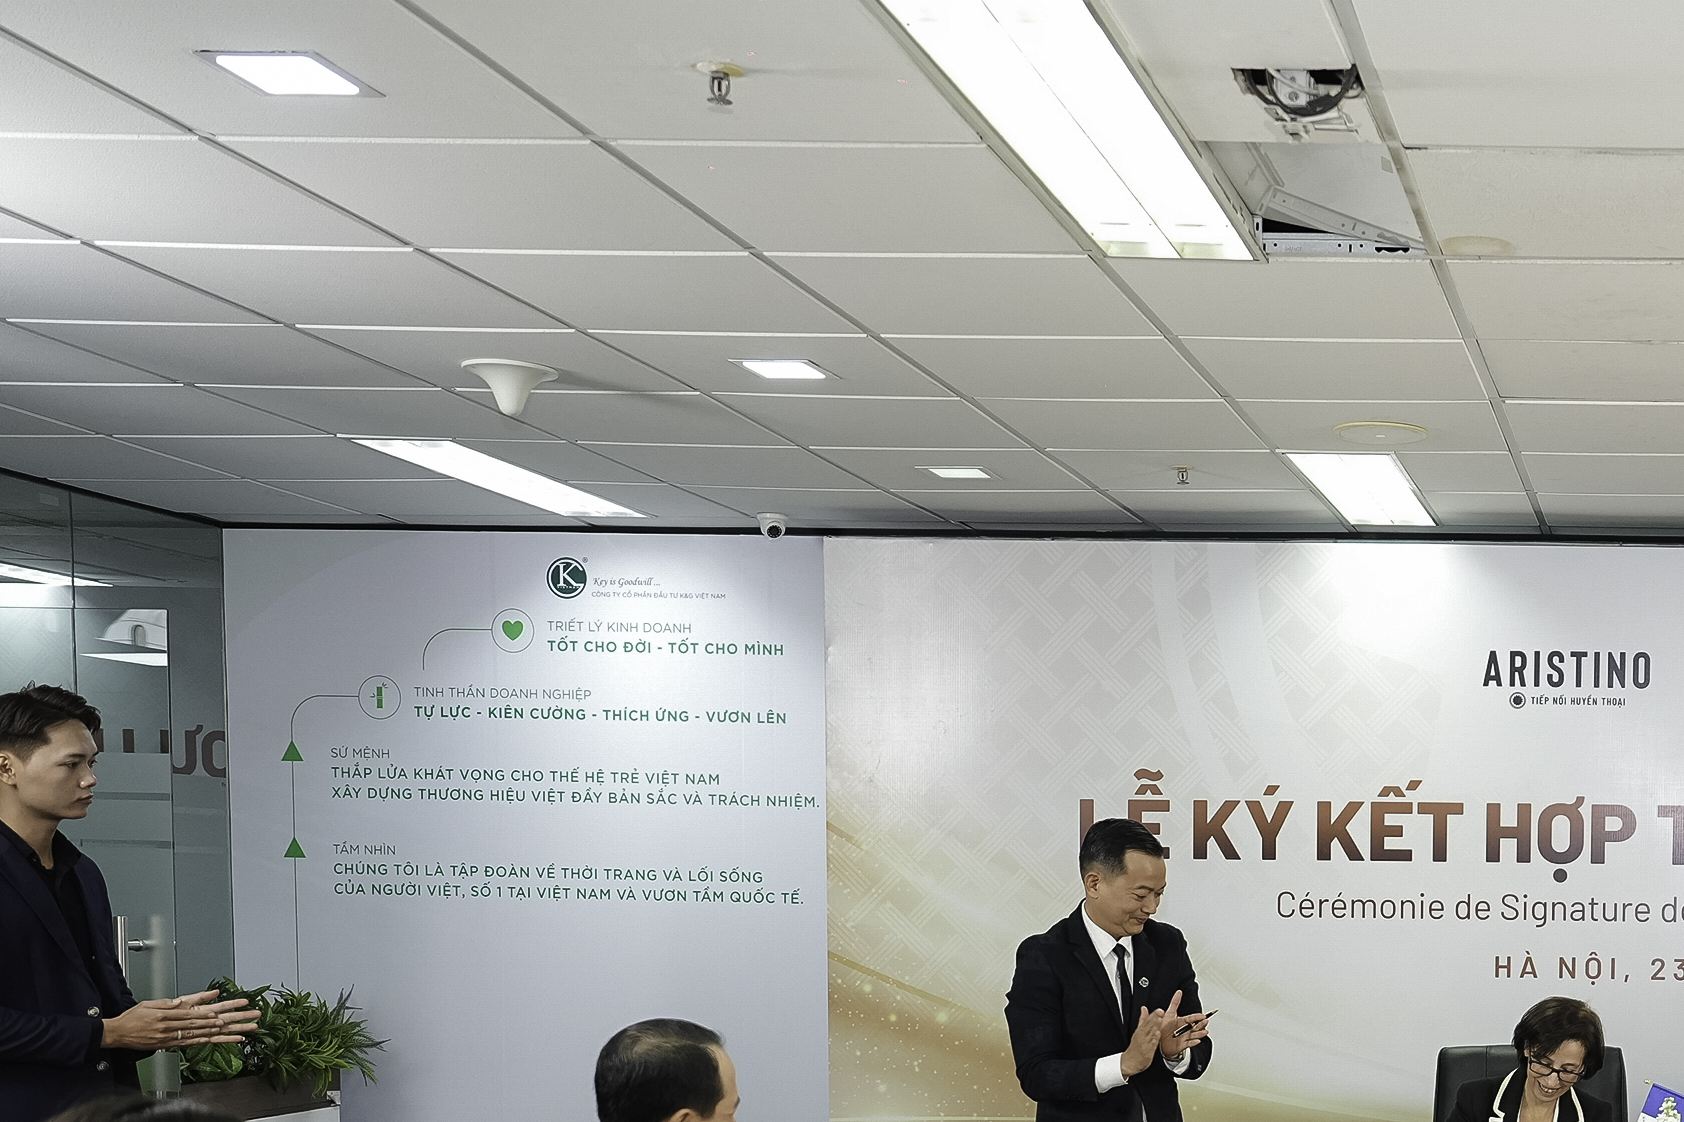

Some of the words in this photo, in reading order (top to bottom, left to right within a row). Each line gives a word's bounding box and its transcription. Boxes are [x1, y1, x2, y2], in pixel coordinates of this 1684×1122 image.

[592, 577, 609, 588] Key
[609, 576, 617, 586] is
[617, 576, 654, 589] Goodwill
[546, 616, 585, 632] TRIẾT
[588, 618, 603, 633] LÝ
[606, 621, 639, 633] KINH
[642, 622, 692, 634] DOANH
[546, 635, 579, 653] TỐT
[583, 640, 618, 653] CHO
[622, 638, 651, 654] ĐỜI
[667, 637, 700, 655] TỐT
[704, 642, 738, 655] CHO
[744, 640, 784, 656] MÌNH
[1483, 651, 1650, 689] ARISTINO
[413, 683, 445, 699] TINH
[447, 683, 486, 699] THẦN
[489, 687, 538, 700] DOANH
[542, 686, 592, 701] NGHIỆP
[1530, 693, 1550, 706] TIẾP
[1552, 693, 1567, 706] NỐI
[1570, 693, 1598, 706] HUYỀN
[1601, 697, 1626, 709] THOẠI
[414, 702, 436, 721] TỰ
[440, 704, 472, 722] LỰC
[488, 703, 524, 720] KIÊN
[529, 704, 586, 721] CƯỜNG
[602, 706, 649, 722] THÍCH
[655, 707, 689, 723] ỨNG
[705, 709, 751, 724] VƯƠN
[757, 708, 787, 725] LÊN
[330, 744, 349, 759] SỨ
[352, 745, 390, 762] MỆNH
[331, 764, 373, 780] THẮP
[377, 762, 409, 781] LỬA
[413, 764, 455, 781] KHÁT
[458, 768, 505, 784] VỌNG
[510, 769, 544, 782] CHO
[549, 766, 580, 783] THẾ
[585, 768, 605, 787] HỆ
[609, 767, 640, 784] TRẺ
[644, 769, 680, 785] VIỆT
[685, 773, 720, 786] NAM
[332, 784, 363, 800] XÂY
[367, 785, 413, 803] DỰNG
[417, 786, 484, 802] THƯƠNG
[489, 786, 526, 805] HIỆU
[530, 787, 566, 806] VIỆT
[570, 787, 603, 804] ĐẦY
[608, 787, 641, 804] BẢN
[646, 788, 678, 805] SẮC
[682, 790, 703, 806] VÀ
[707, 790, 760, 807] TRÁCH
[766, 792, 820, 811] NHIỆM.
[1193, 785, 1294, 860] KÝ
[1317, 780, 1464, 862] KẾT
[1486, 796, 1636, 882] HỢP
[332, 840, 360, 855] TẦM
[364, 842, 396, 856] NHÌN
[333, 860, 388, 876] CHÚNG
[392, 861, 419, 877] TÔI
[424, 861, 445, 877] LÀ
[449, 861, 479, 880] TẬP
[483, 862, 530, 879] ĐOÀN
[535, 863, 556, 879] VỀ
[560, 864, 598, 880] THỜI
[603, 868, 657, 882] TRANG
[662, 866, 683, 882] VÀ
[688, 865, 714, 883] LỐI
[719, 866, 763, 884] SỐNG
[334, 879, 367, 896] CỦA
[371, 881, 421, 897] NGƯỜI
[426, 881, 466, 900] VIỆT,
[470, 882, 492, 898] SỐ
[506, 886, 531, 902] TẠI
[536, 884, 571, 902] VIỆT
[576, 887, 611, 901] NAM
[616, 885, 637, 901] VÀ
[641, 887, 687, 902] VƯƠN
[692, 885, 724, 903] TẦM
[729, 886, 776, 904] QUỐC
[780, 887, 804, 905] TẾ.
[1277, 890, 1445, 920] Cérémonie
[1455, 893, 1491, 921] de
[1500, 893, 1651, 928] Signature
[1494, 950, 1539, 979] HÀ
[1558, 951, 1630, 986] NỘI,
